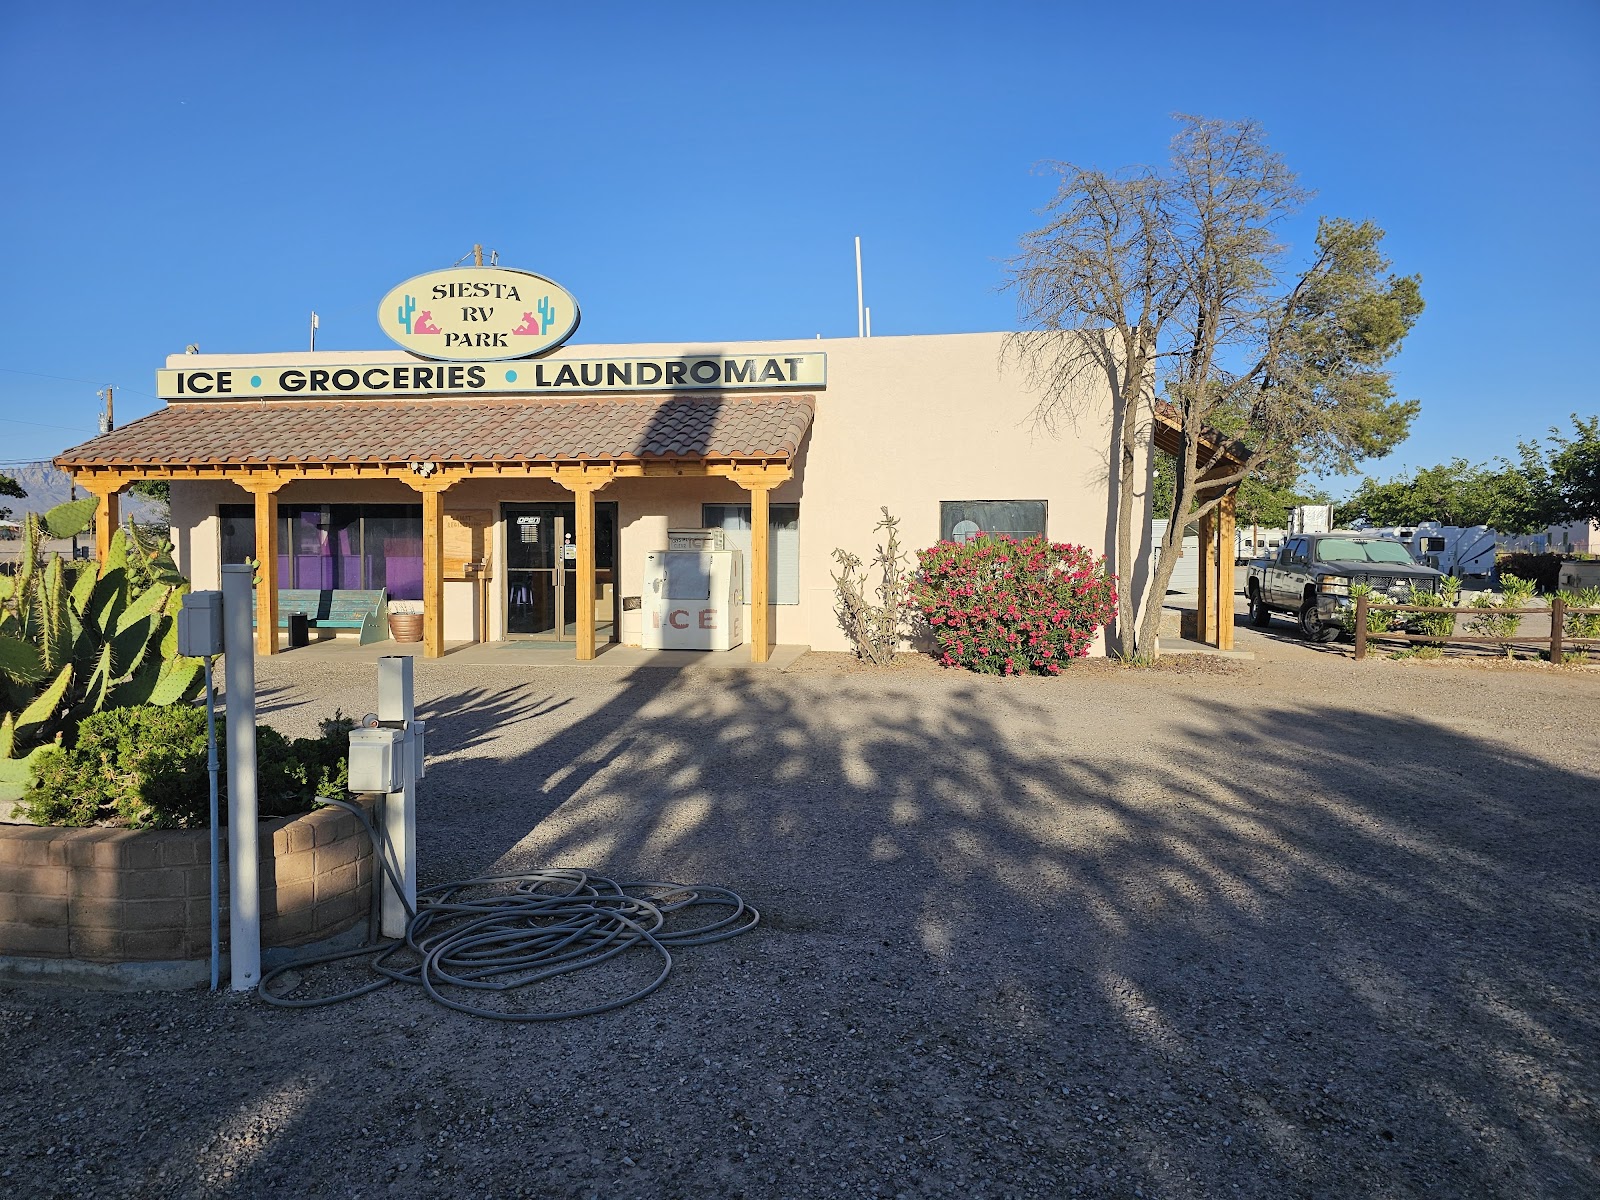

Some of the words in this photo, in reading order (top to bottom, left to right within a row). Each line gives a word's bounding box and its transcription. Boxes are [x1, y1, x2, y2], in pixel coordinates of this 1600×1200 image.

[432, 282, 522, 301] SIESTA
[461, 306, 494, 322] RV
[444, 332, 509, 348] PARK
[177, 371, 232, 394] ICE
[279, 365, 486, 391] GROCERIES
[536, 357, 805, 387] LAUNDROMAT
[688, 538, 711, 549] ICE
[653, 608, 718, 630] ICE
